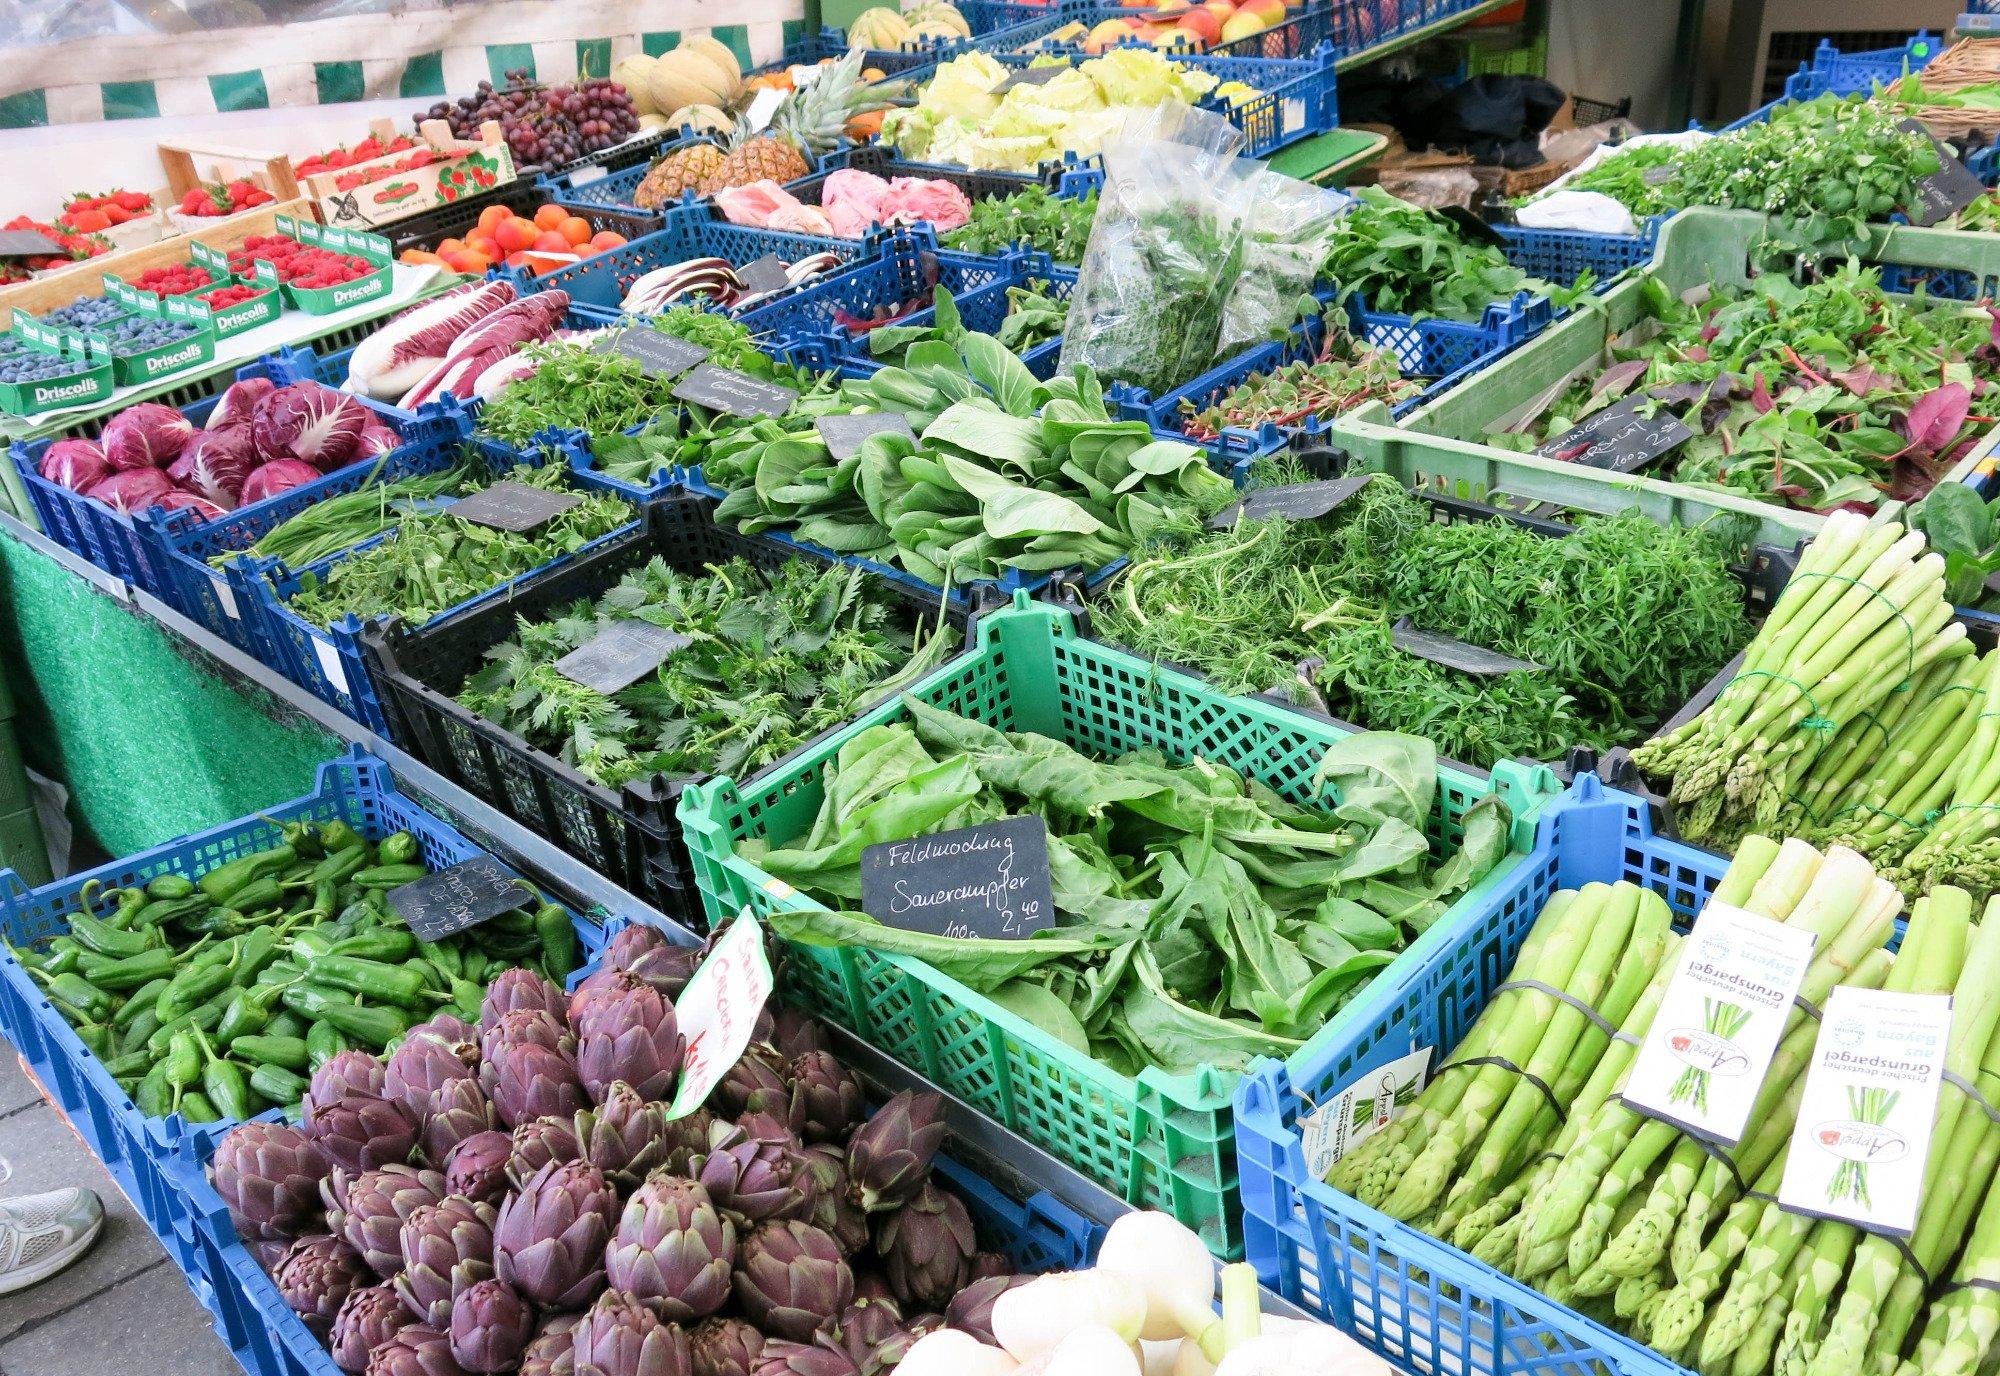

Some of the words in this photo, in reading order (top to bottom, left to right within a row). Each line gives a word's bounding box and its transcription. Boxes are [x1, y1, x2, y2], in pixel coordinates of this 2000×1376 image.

[333, 278, 383, 303] Driscoll's
[216, 302, 268, 330] Driscoll's
[145, 344, 201, 371] Driscoll's
[35, 378, 98, 402] Driscoll's
[889, 833, 1015, 872] Feldmoching
[891, 869, 1030, 913] Sauerampfer
[1876, 1030, 1937, 1046] Bayern
[1882, 1070, 1928, 1084] Frischer
